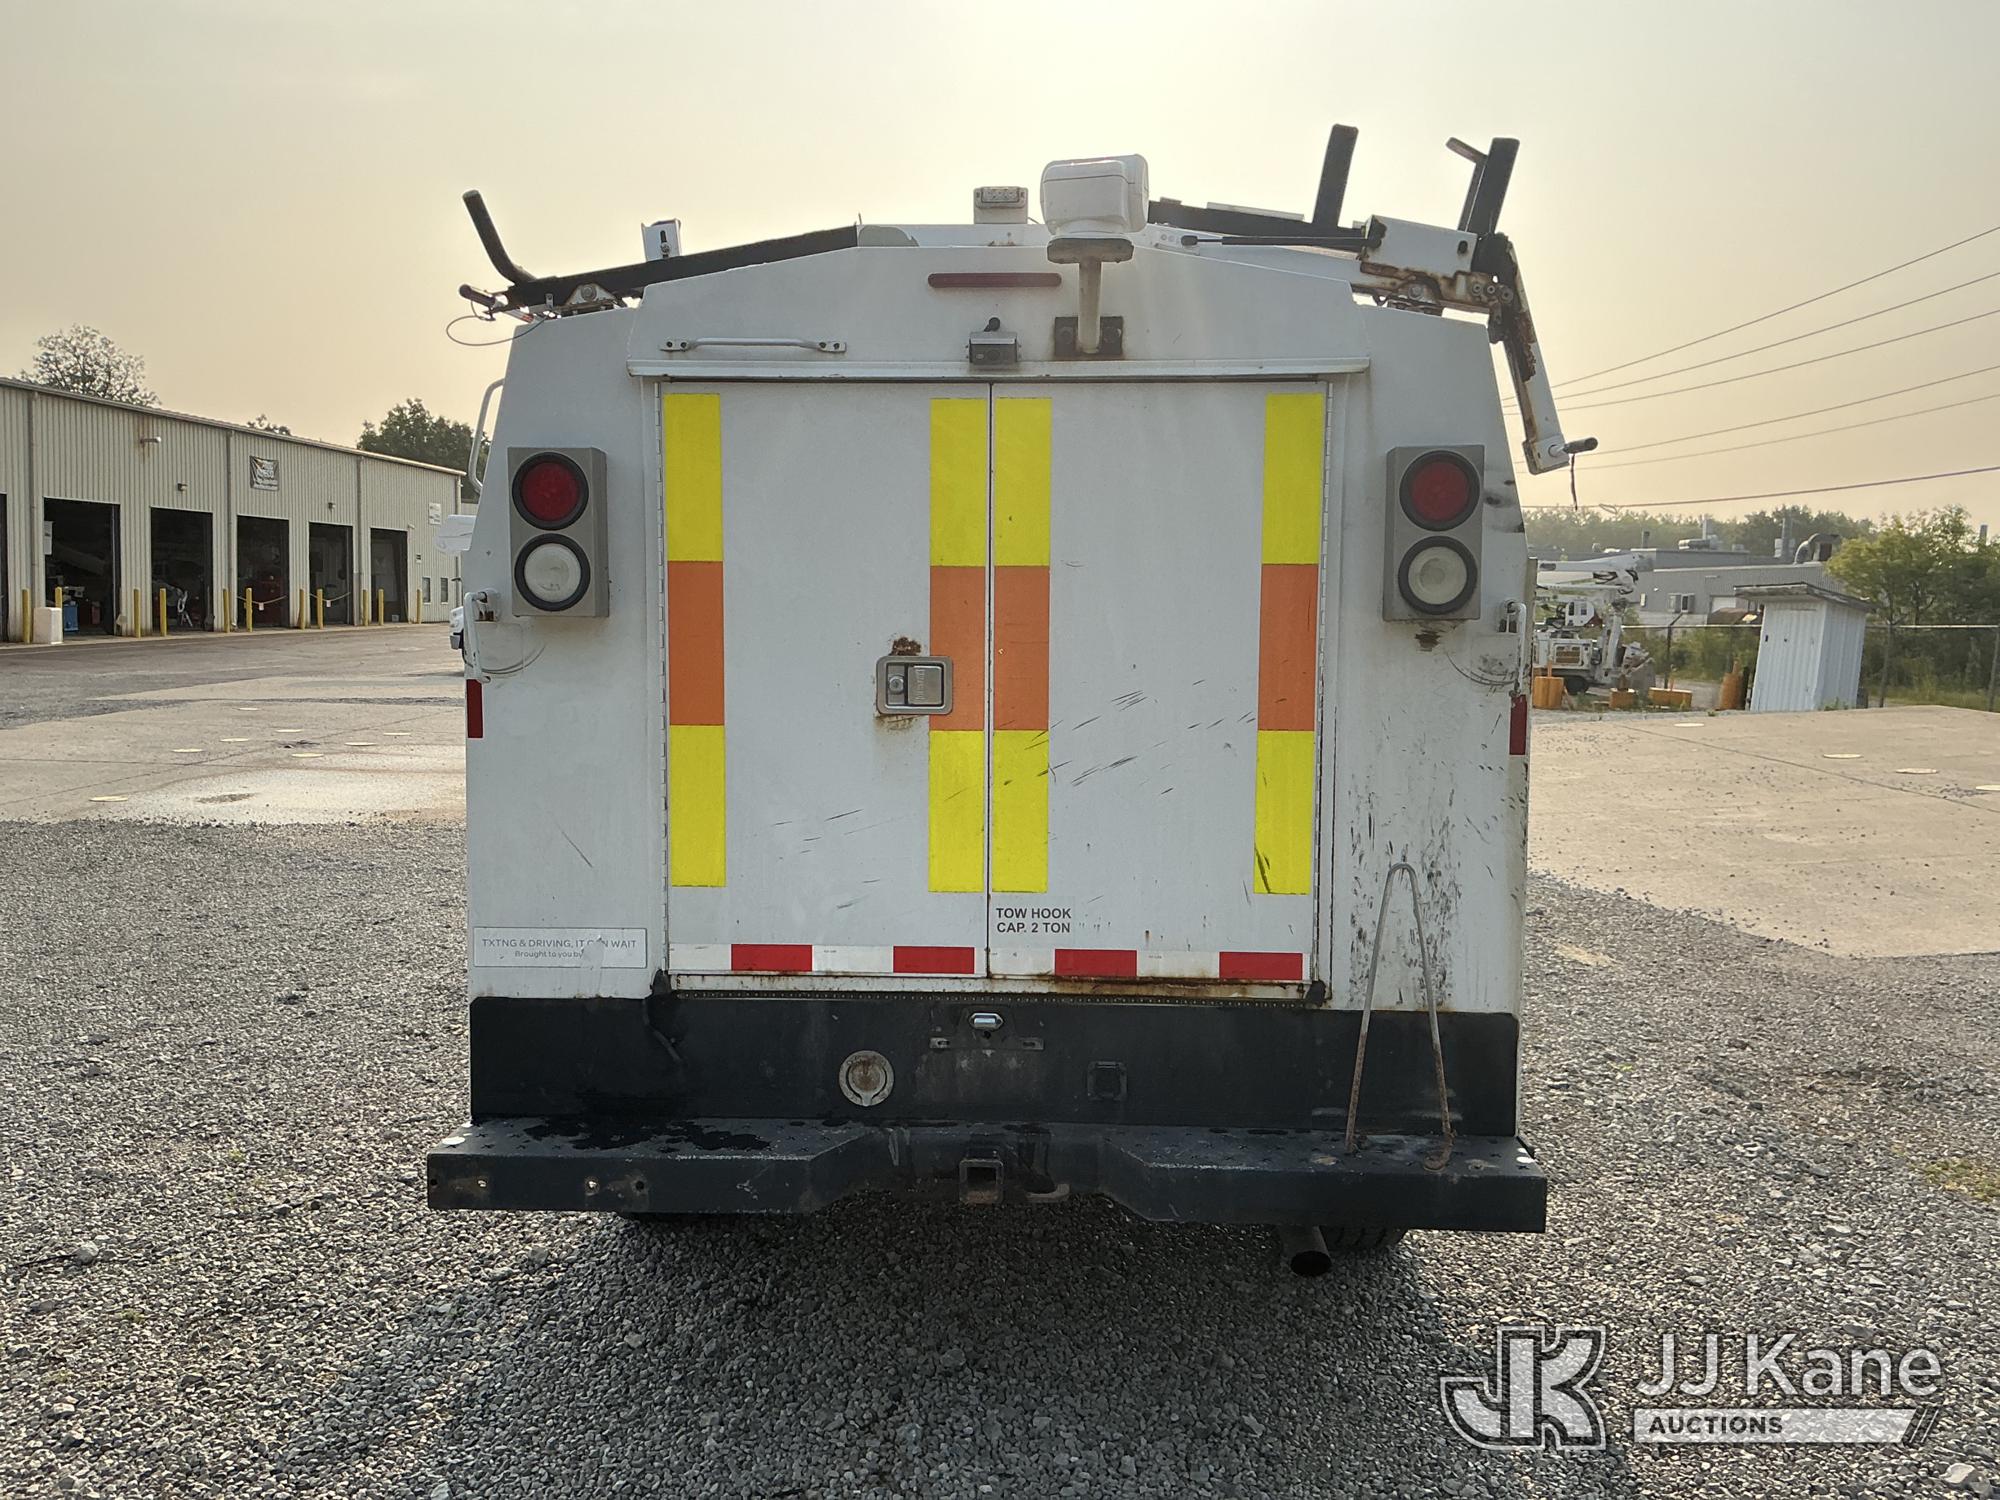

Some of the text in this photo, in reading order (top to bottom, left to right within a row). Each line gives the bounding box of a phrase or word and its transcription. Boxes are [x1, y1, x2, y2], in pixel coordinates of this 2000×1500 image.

[995, 907, 1072, 919] TOW HOOK
[996, 922, 1071, 933] CAP. 2 TON
[481, 938, 637, 949] TXTNG & DRIVING, IT CN WAIT
[514, 950, 547, 959] Brought
[548, 950, 557, 958] to
[558, 951, 572, 959] you
